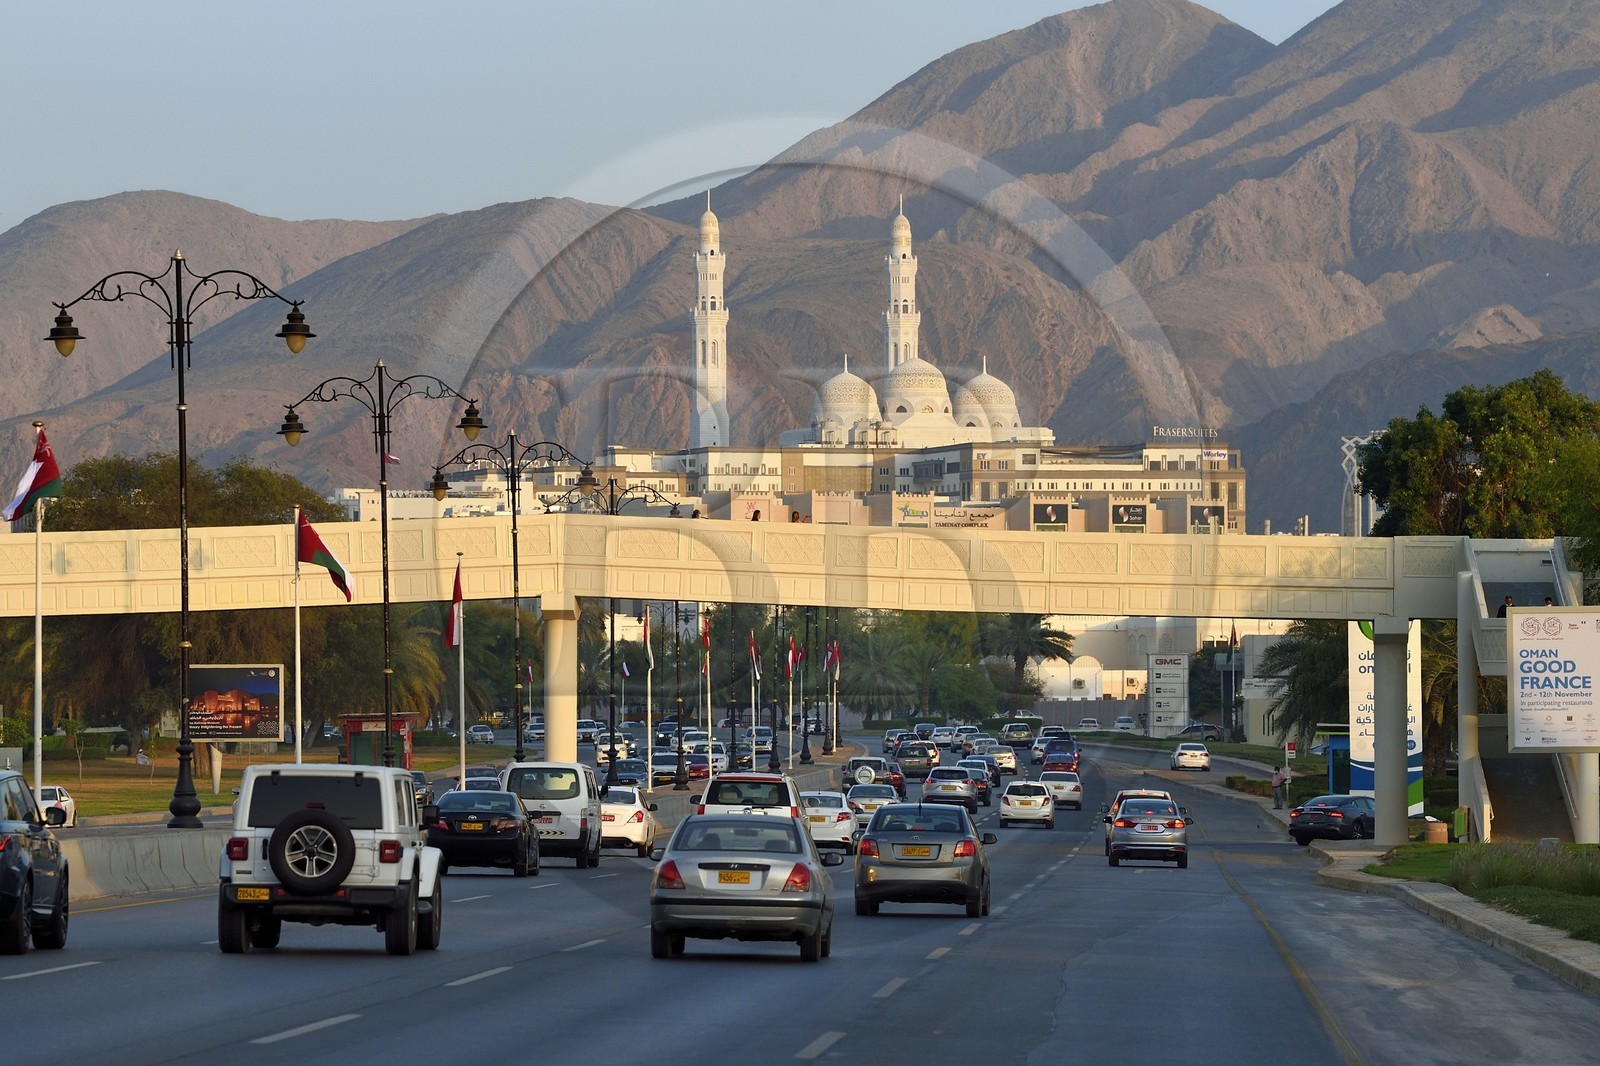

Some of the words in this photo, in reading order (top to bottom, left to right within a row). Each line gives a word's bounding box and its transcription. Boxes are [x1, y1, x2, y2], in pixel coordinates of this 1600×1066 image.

[976, 452, 987, 460] EY
[1203, 450, 1227, 459] Worley
[1519, 649, 1559, 659] OMAN
[1519, 660, 1577, 674] GOOD
[1520, 675, 1592, 690] FRANCE
[1527, 700, 1561, 708] participating
